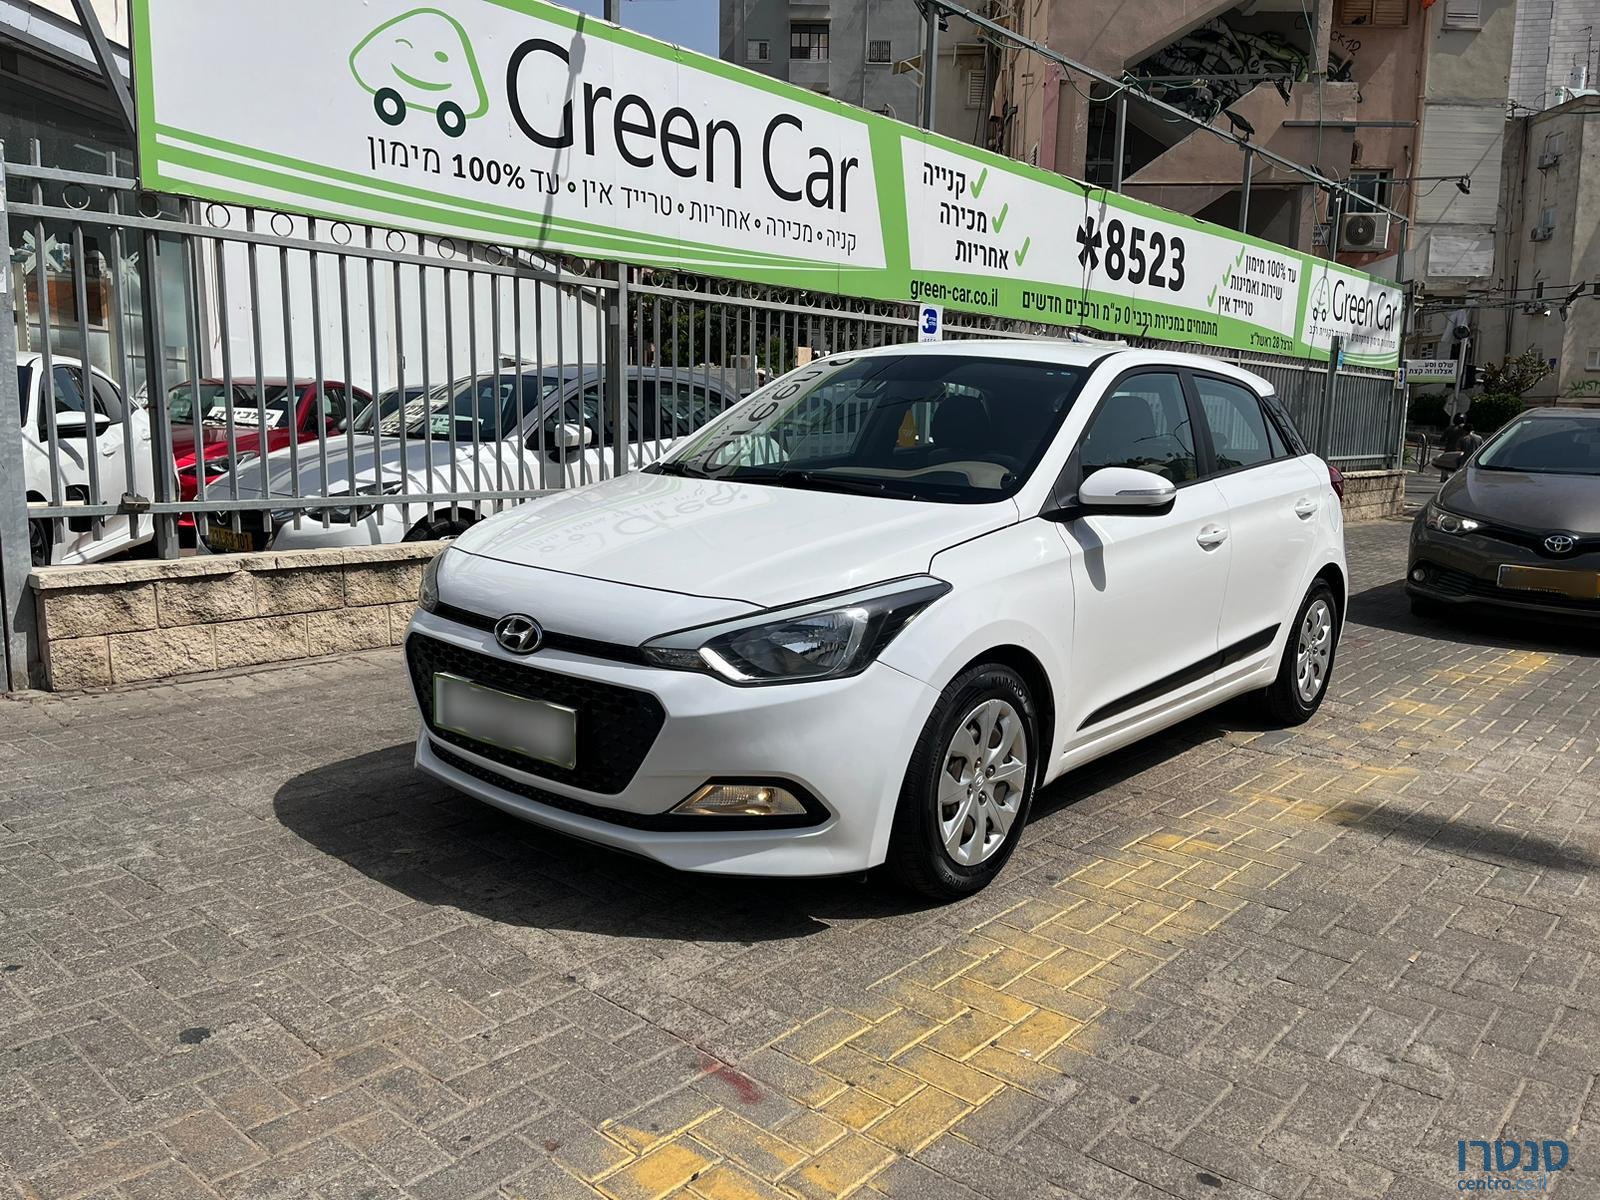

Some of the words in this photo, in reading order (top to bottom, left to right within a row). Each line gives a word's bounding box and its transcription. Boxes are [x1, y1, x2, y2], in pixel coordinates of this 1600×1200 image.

[506, 38, 741, 189] Green
[762, 113, 859, 213] Car
[367, 136, 441, 174] מימון
[452, 153, 526, 190] 100%
[530, 168, 560, 195] עד
[923, 161, 967, 200] קנייה
[582, 178, 613, 208] אין
[620, 186, 673, 216] טרייד
[688, 200, 751, 232] אחריות
[766, 216, 813, 243] מכירה
[940, 201, 987, 234] מכירה
[826, 229, 857, 256] קניה
[955, 239, 1009, 270] אחריות
[1245, 255, 1265, 274] מימון
[1267, 259, 1286, 280] 100%
[1287, 267, 1297, 283] עד
[910, 279, 998, 307] green-car.co.il
[1230, 274, 1260, 295] ואמינות
[1260, 282, 1283, 301] שירות
[1022, 291, 1062, 313] חדשים
[1065, 298, 1100, 320] ורכבים
[1124, 306, 1131, 325] 0
[1218, 295, 1231, 314] אין
[1232, 298, 1254, 316] טרייד
[1333, 279, 1374, 328] Green
[1376, 291, 1398, 332] Car
[1132, 310, 1153, 328] רכבי
[1154, 313, 1185, 331] במכירת
[1187, 318, 1218, 337] מתמחים
